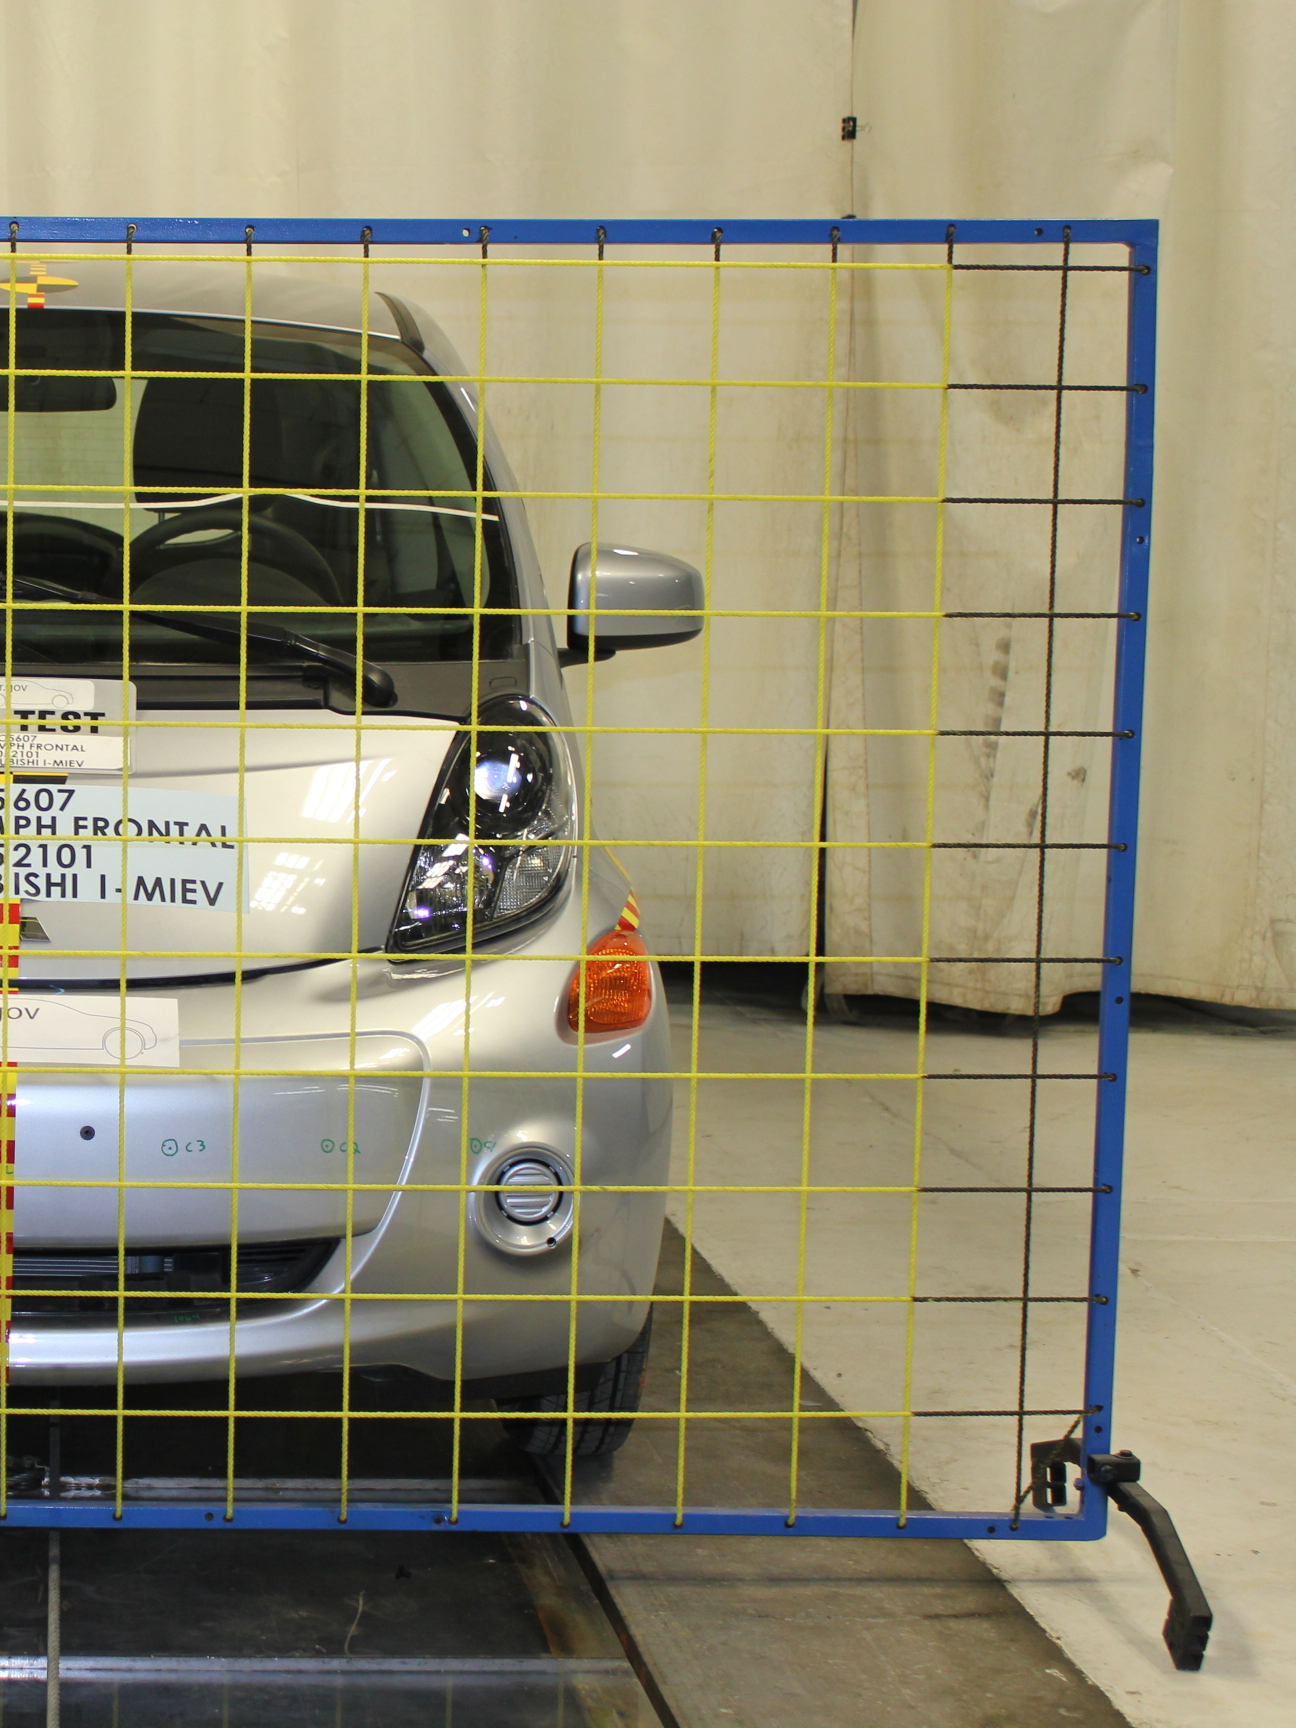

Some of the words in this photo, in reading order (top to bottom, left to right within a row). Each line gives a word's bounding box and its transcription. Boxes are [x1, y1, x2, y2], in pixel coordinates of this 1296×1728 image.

[13, 710, 106, 734] TEST
[29, 743, 86, 752] FRONTAL
[43, 759, 85, 768] I-MIEV
[73, 816, 235, 850] FRONTAL
